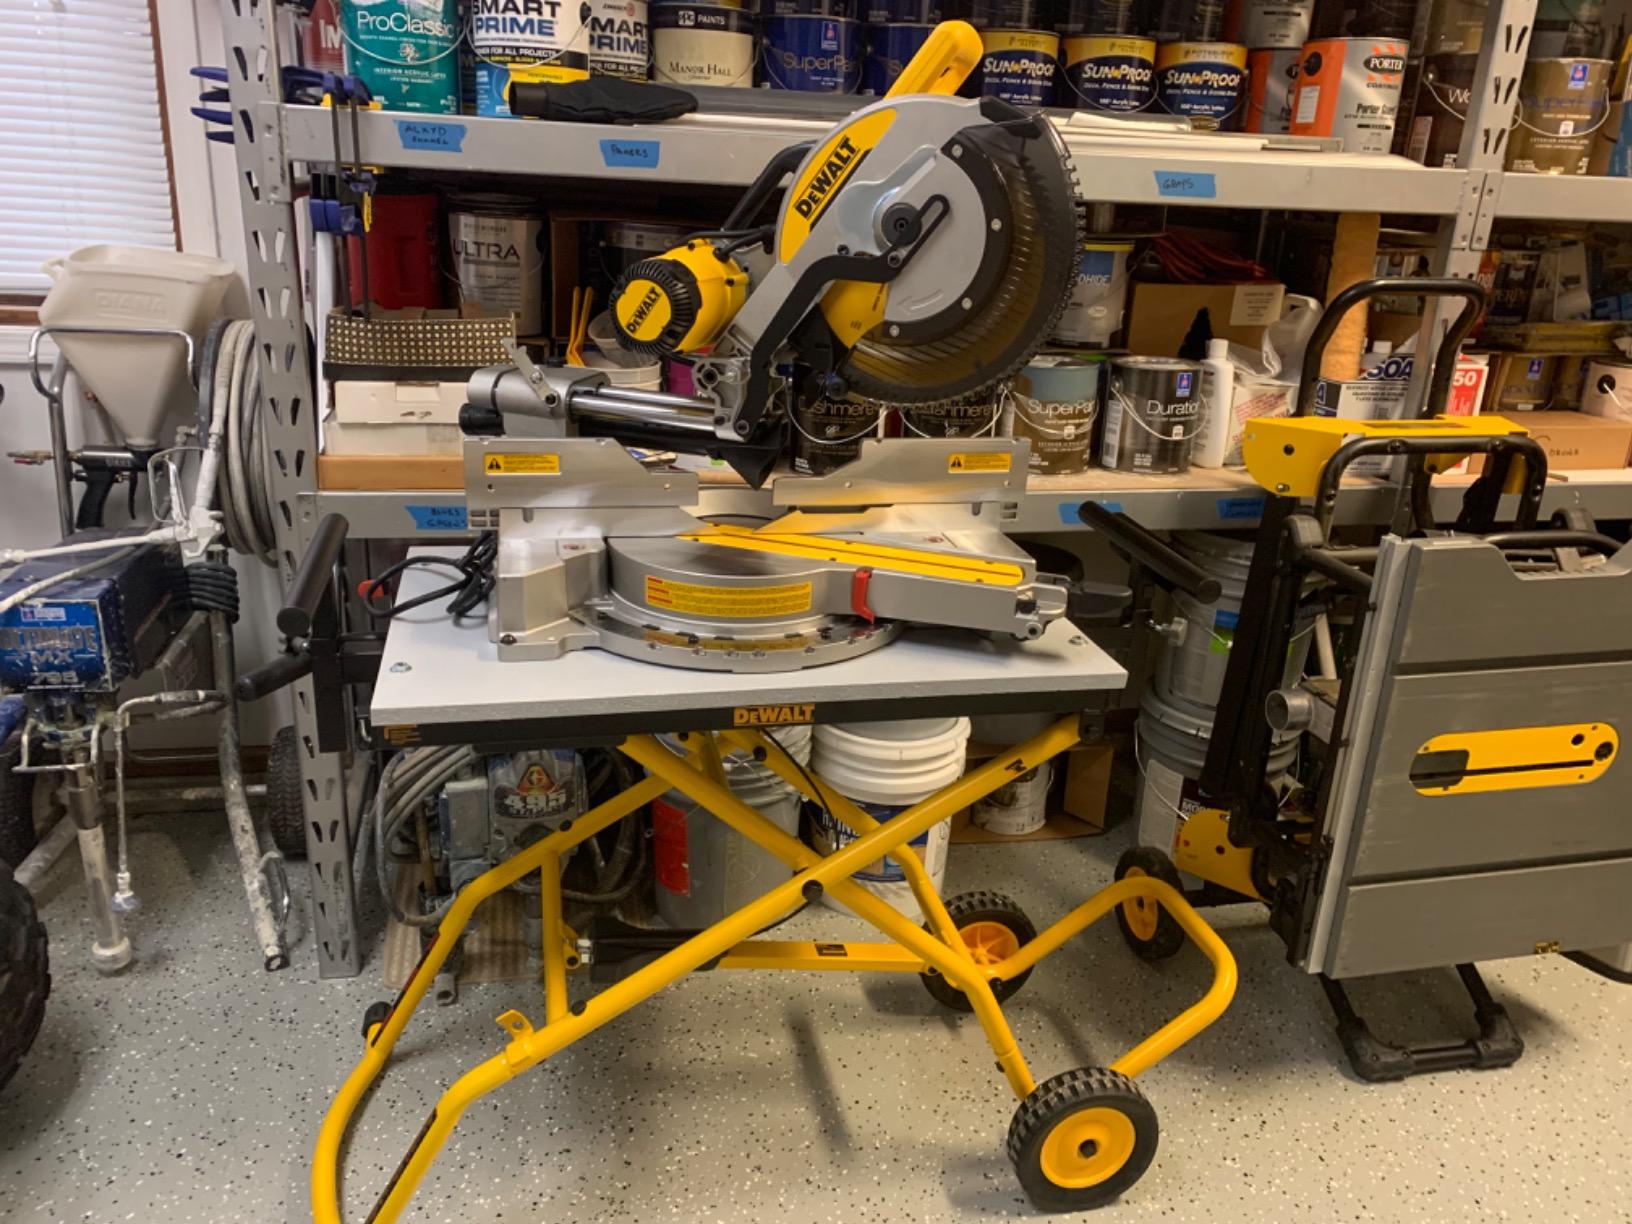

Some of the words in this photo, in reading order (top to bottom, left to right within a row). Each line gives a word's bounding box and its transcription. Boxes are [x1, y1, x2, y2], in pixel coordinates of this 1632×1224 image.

[357, 10, 454, 38] ProClassic
[475, 16, 556, 37] PRIME
[697, 14, 726, 25] PAINTS
[669, 61, 704, 74] MANOR
[707, 63, 732, 77] HALL
[452, 238, 520, 260] ULTRA
